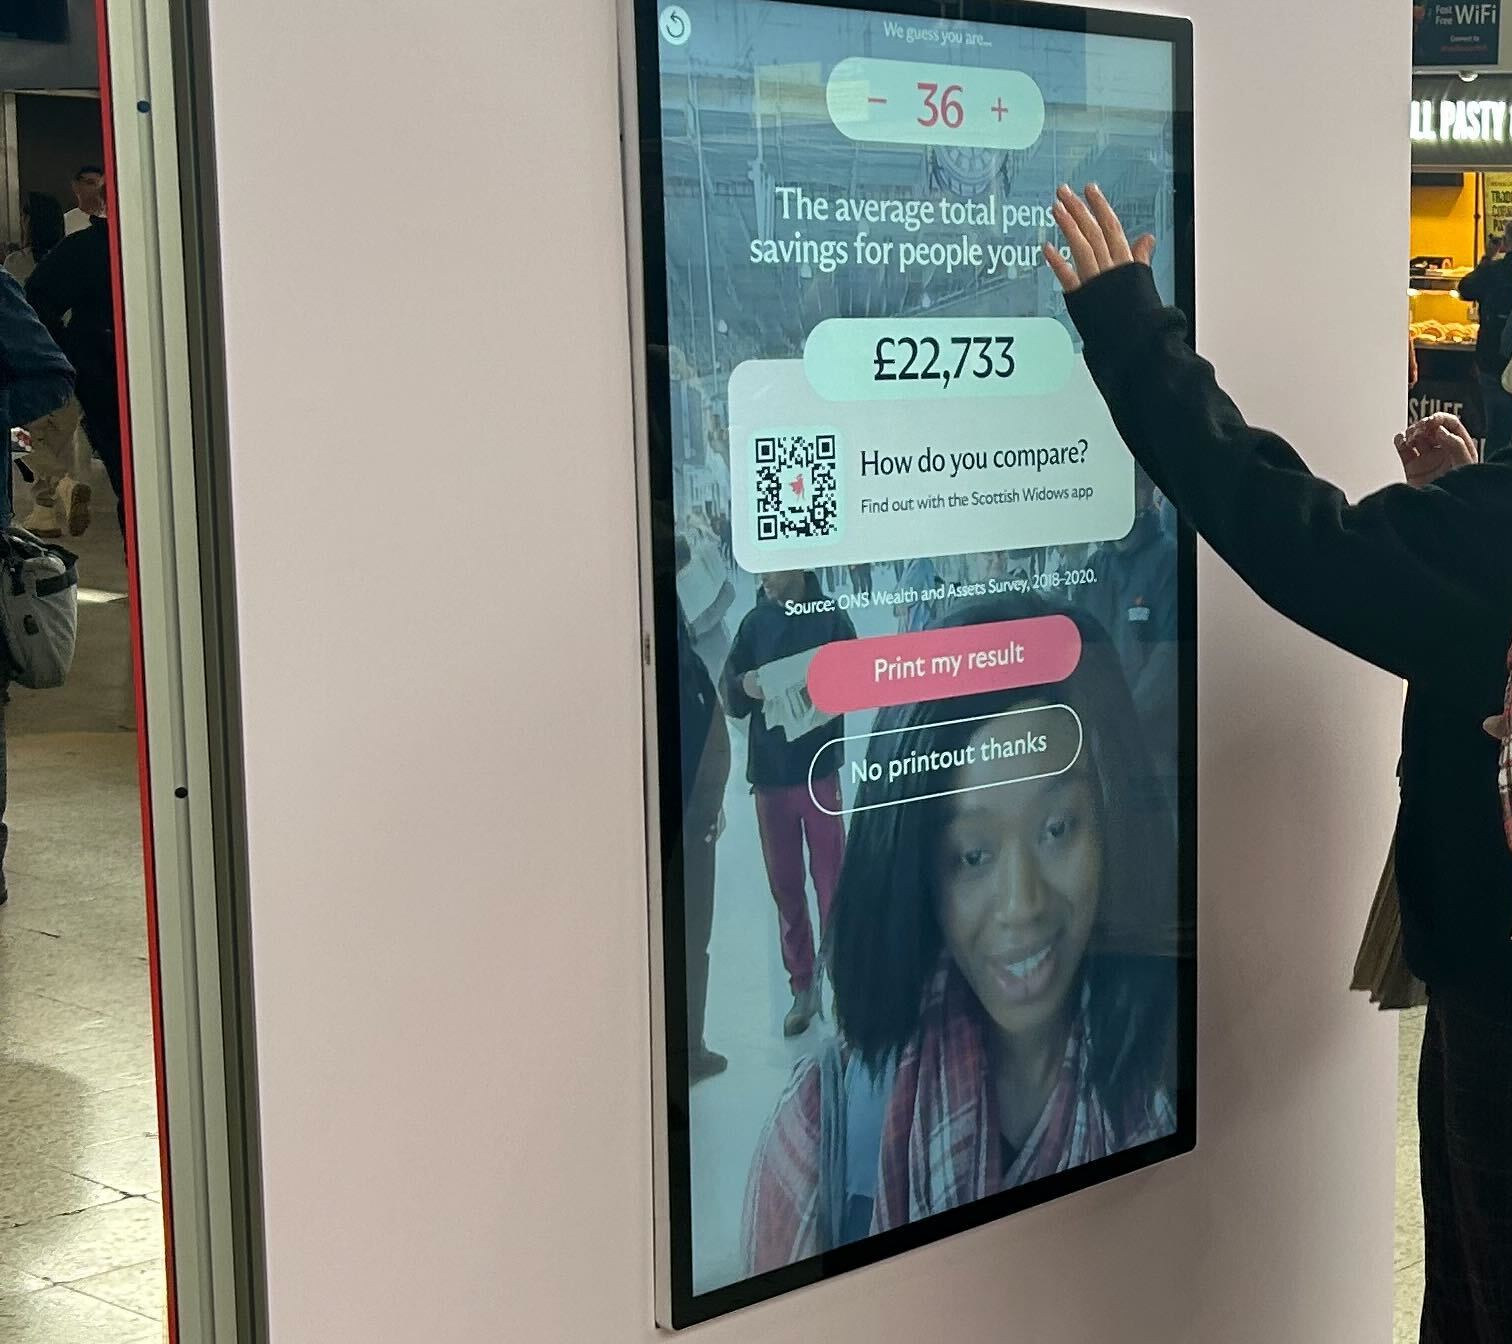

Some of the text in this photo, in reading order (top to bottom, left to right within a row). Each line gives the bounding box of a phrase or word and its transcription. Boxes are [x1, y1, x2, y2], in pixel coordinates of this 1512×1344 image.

[883, 20, 904, 39] We
[905, 26, 940, 44] guess
[941, 30, 963, 47] you
[1455, 4, 1496, 25] WiFi
[916, 82, 965, 129] 36
[1439, 99, 1506, 141] PASTY
[775, 186, 1056, 234] The average total pens
[749, 231, 848, 273] savings
[854, 231, 894, 265] for
[899, 234, 983, 274] people
[987, 245, 1042, 275] your
[873, 335, 1016, 389] £22,733
[860, 438, 1090, 478] How do you compare?
[860, 485, 1094, 514] Find out with the Scottish Widows app
[784, 598, 836, 617] Source:
[838, 592, 870, 610] ONS
[872, 586, 919, 606] Wealth
[921, 584, 945, 602] and
[947, 581, 986, 599] Assets
[988, 575, 1030, 595] Survey,
[873, 642, 1025, 683] Print my result
[851, 732, 1048, 785] No printout thanks
